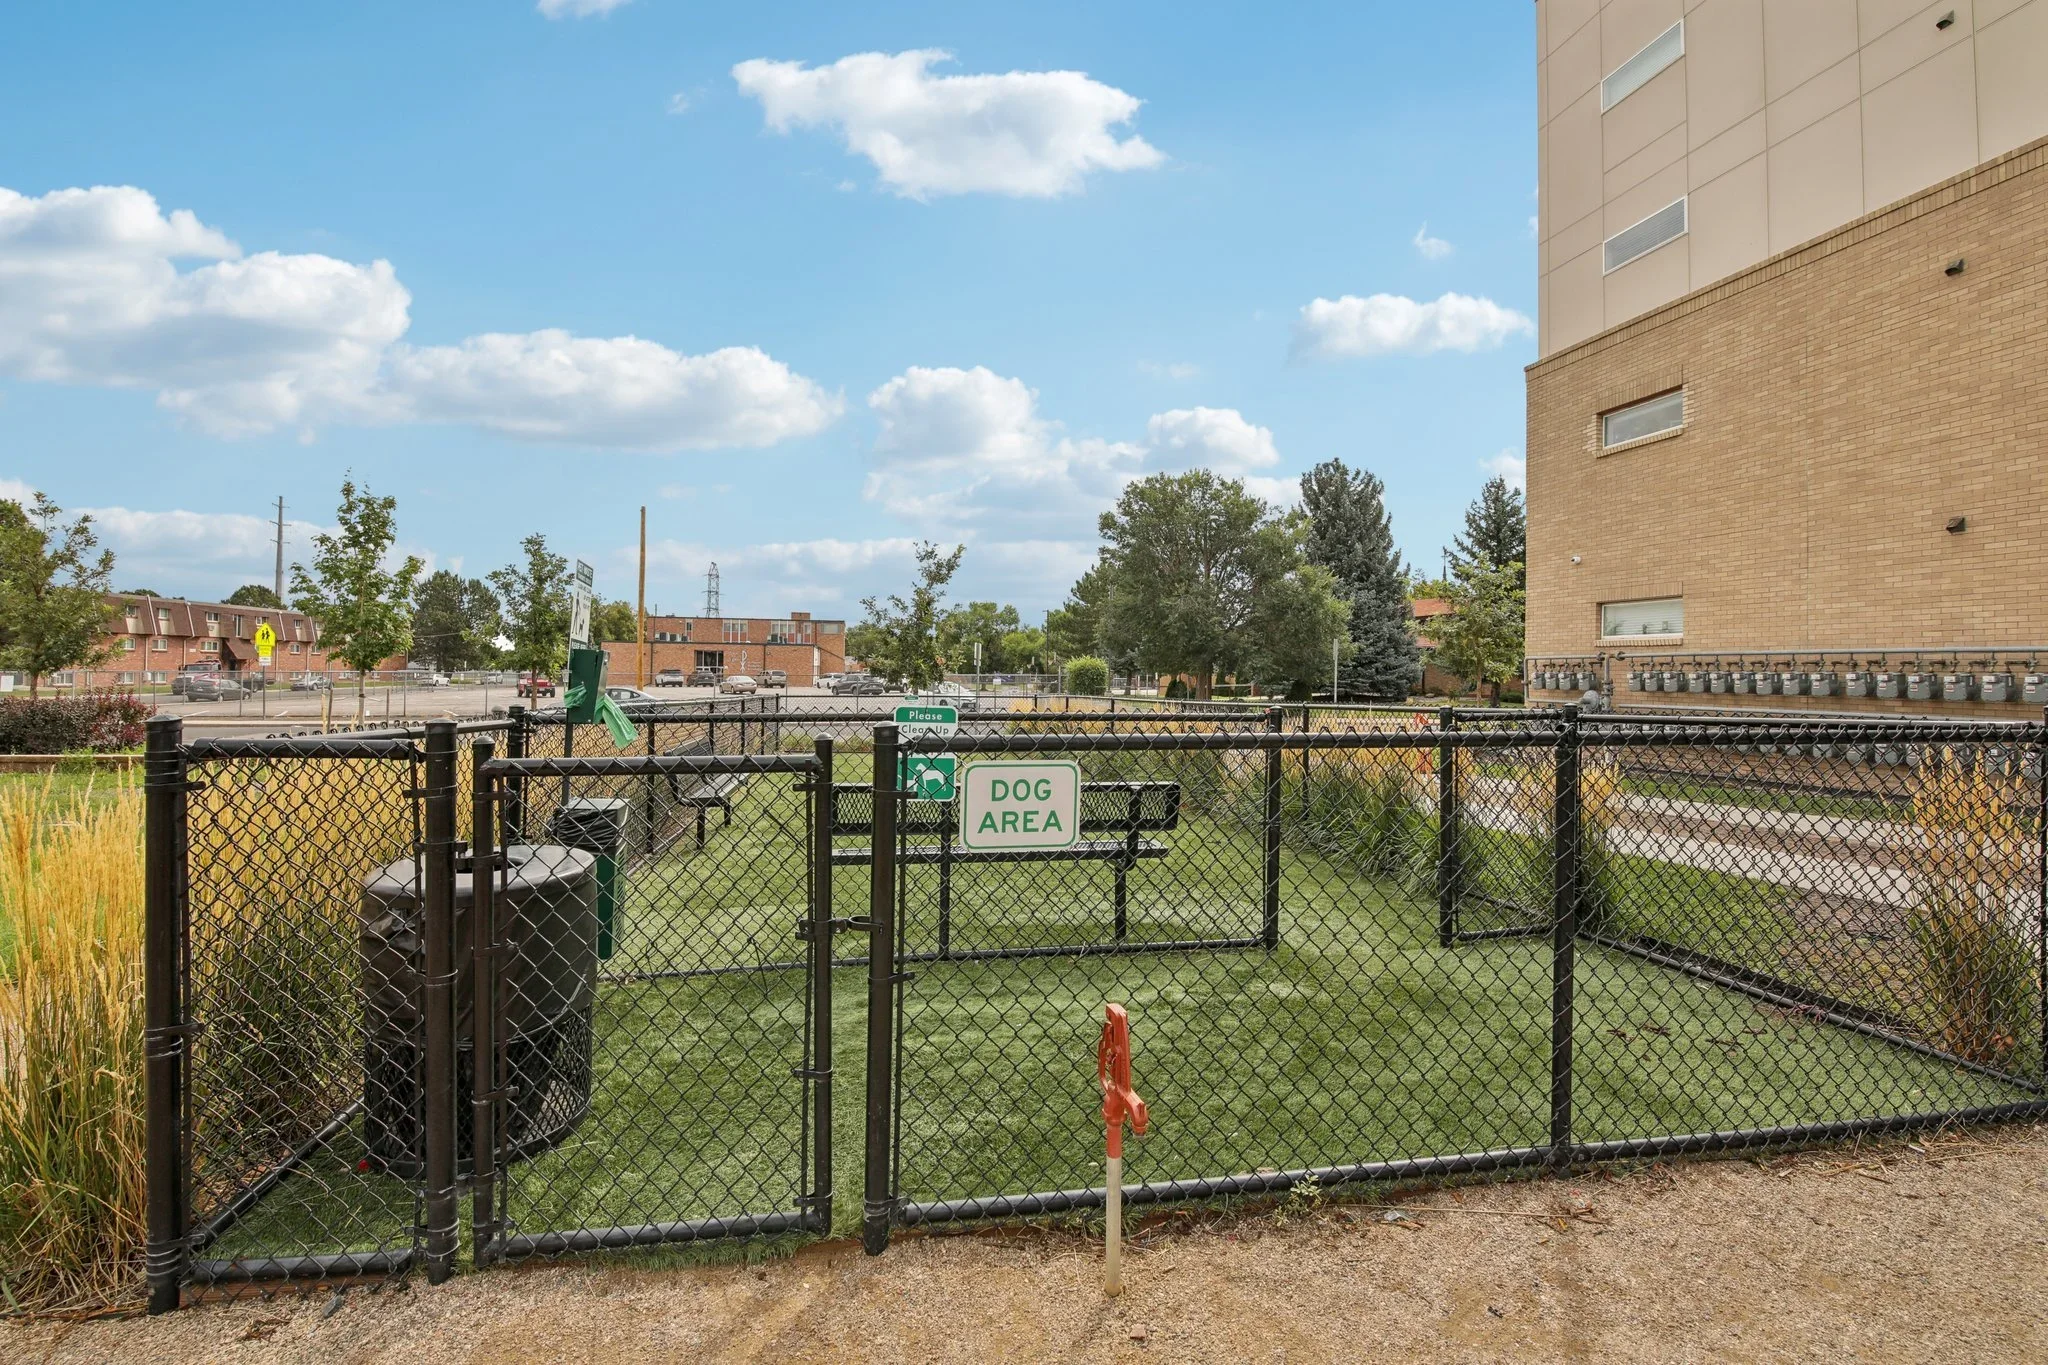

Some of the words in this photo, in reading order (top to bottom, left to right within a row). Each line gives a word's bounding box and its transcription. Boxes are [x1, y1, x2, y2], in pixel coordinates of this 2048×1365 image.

[909, 710, 942, 720] Please
[901, 724, 931, 734] Clea
[936, 726, 949, 736] Up
[991, 778, 1052, 802] DOG
[977, 810, 1063, 834] AREA
